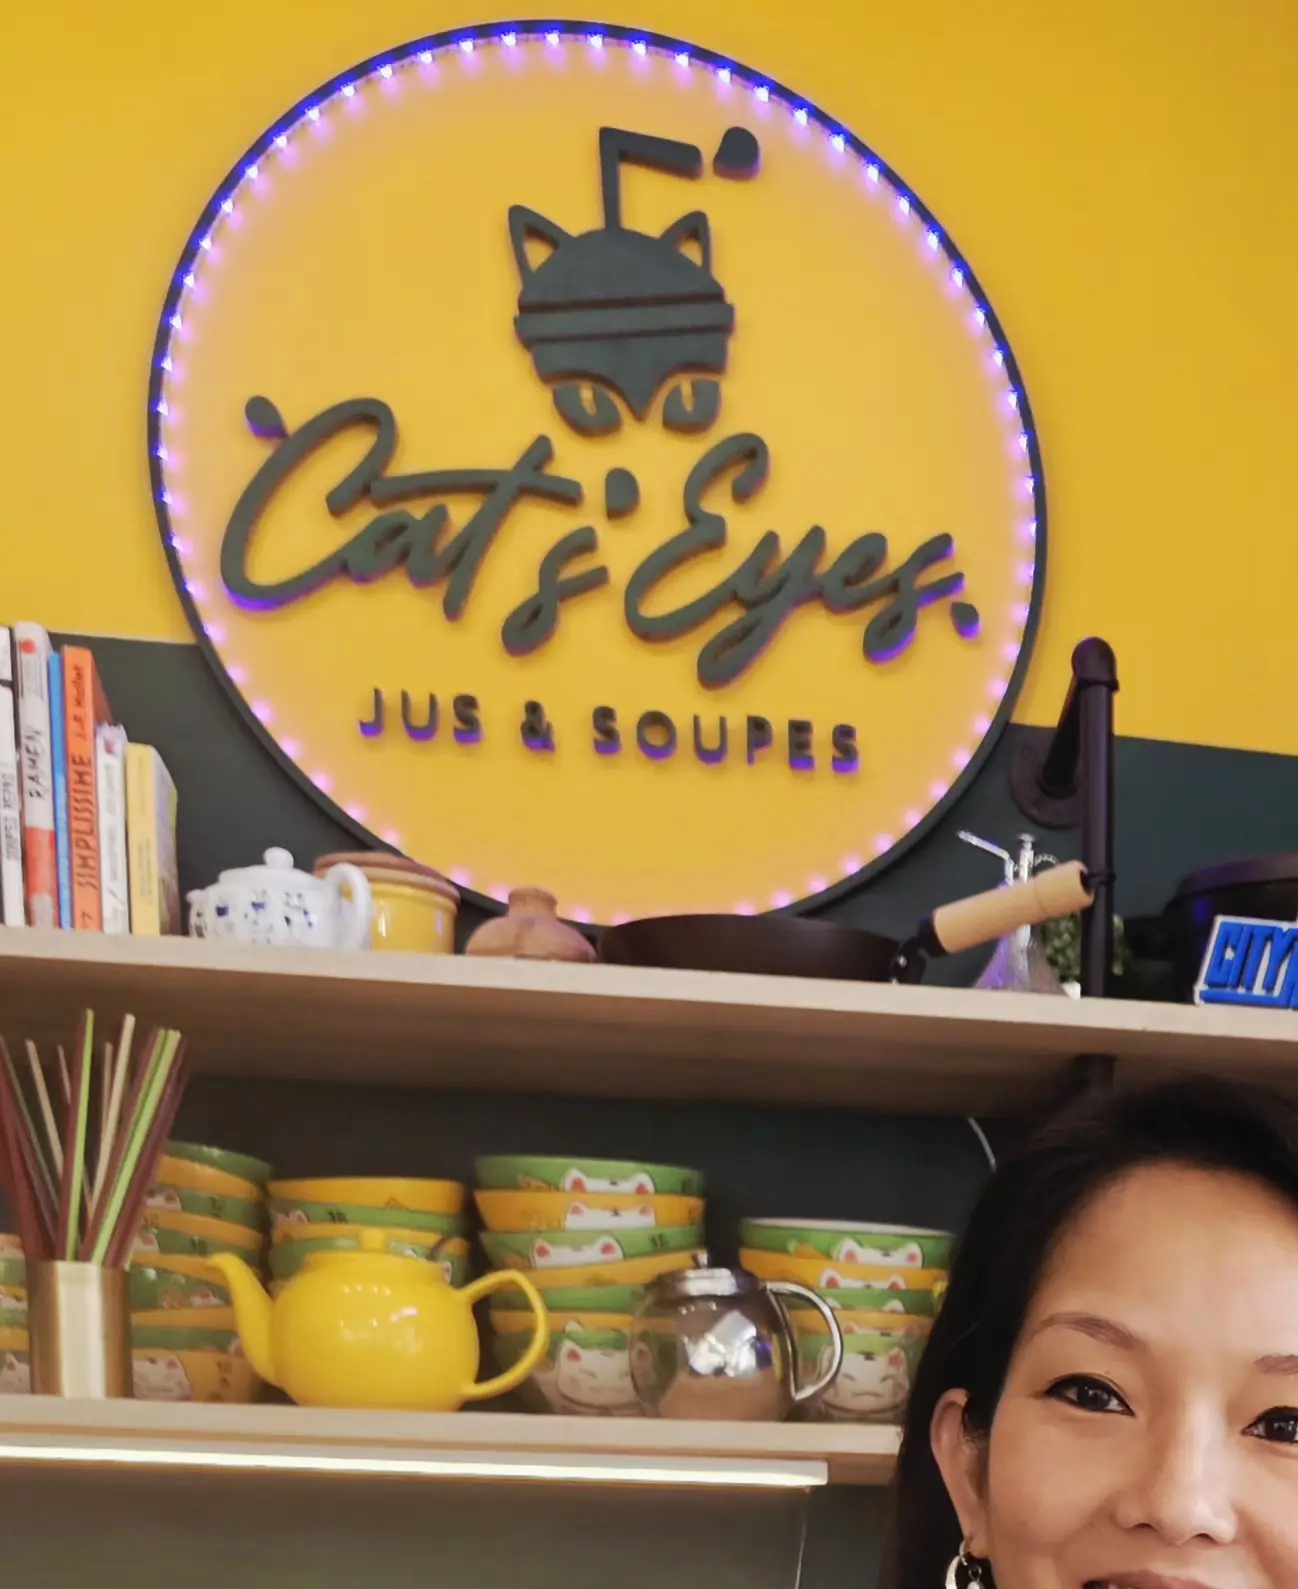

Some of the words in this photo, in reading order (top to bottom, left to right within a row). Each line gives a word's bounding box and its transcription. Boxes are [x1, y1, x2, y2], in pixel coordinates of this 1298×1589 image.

[220, 396, 638, 656] Cat's
[358, 686, 482, 744] JUS
[519, 699, 557, 752] &
[592, 703, 861, 774] SOUPES
[71, 754, 98, 890] SIMPLISSIME
[1206, 921, 1298, 991] CITY
